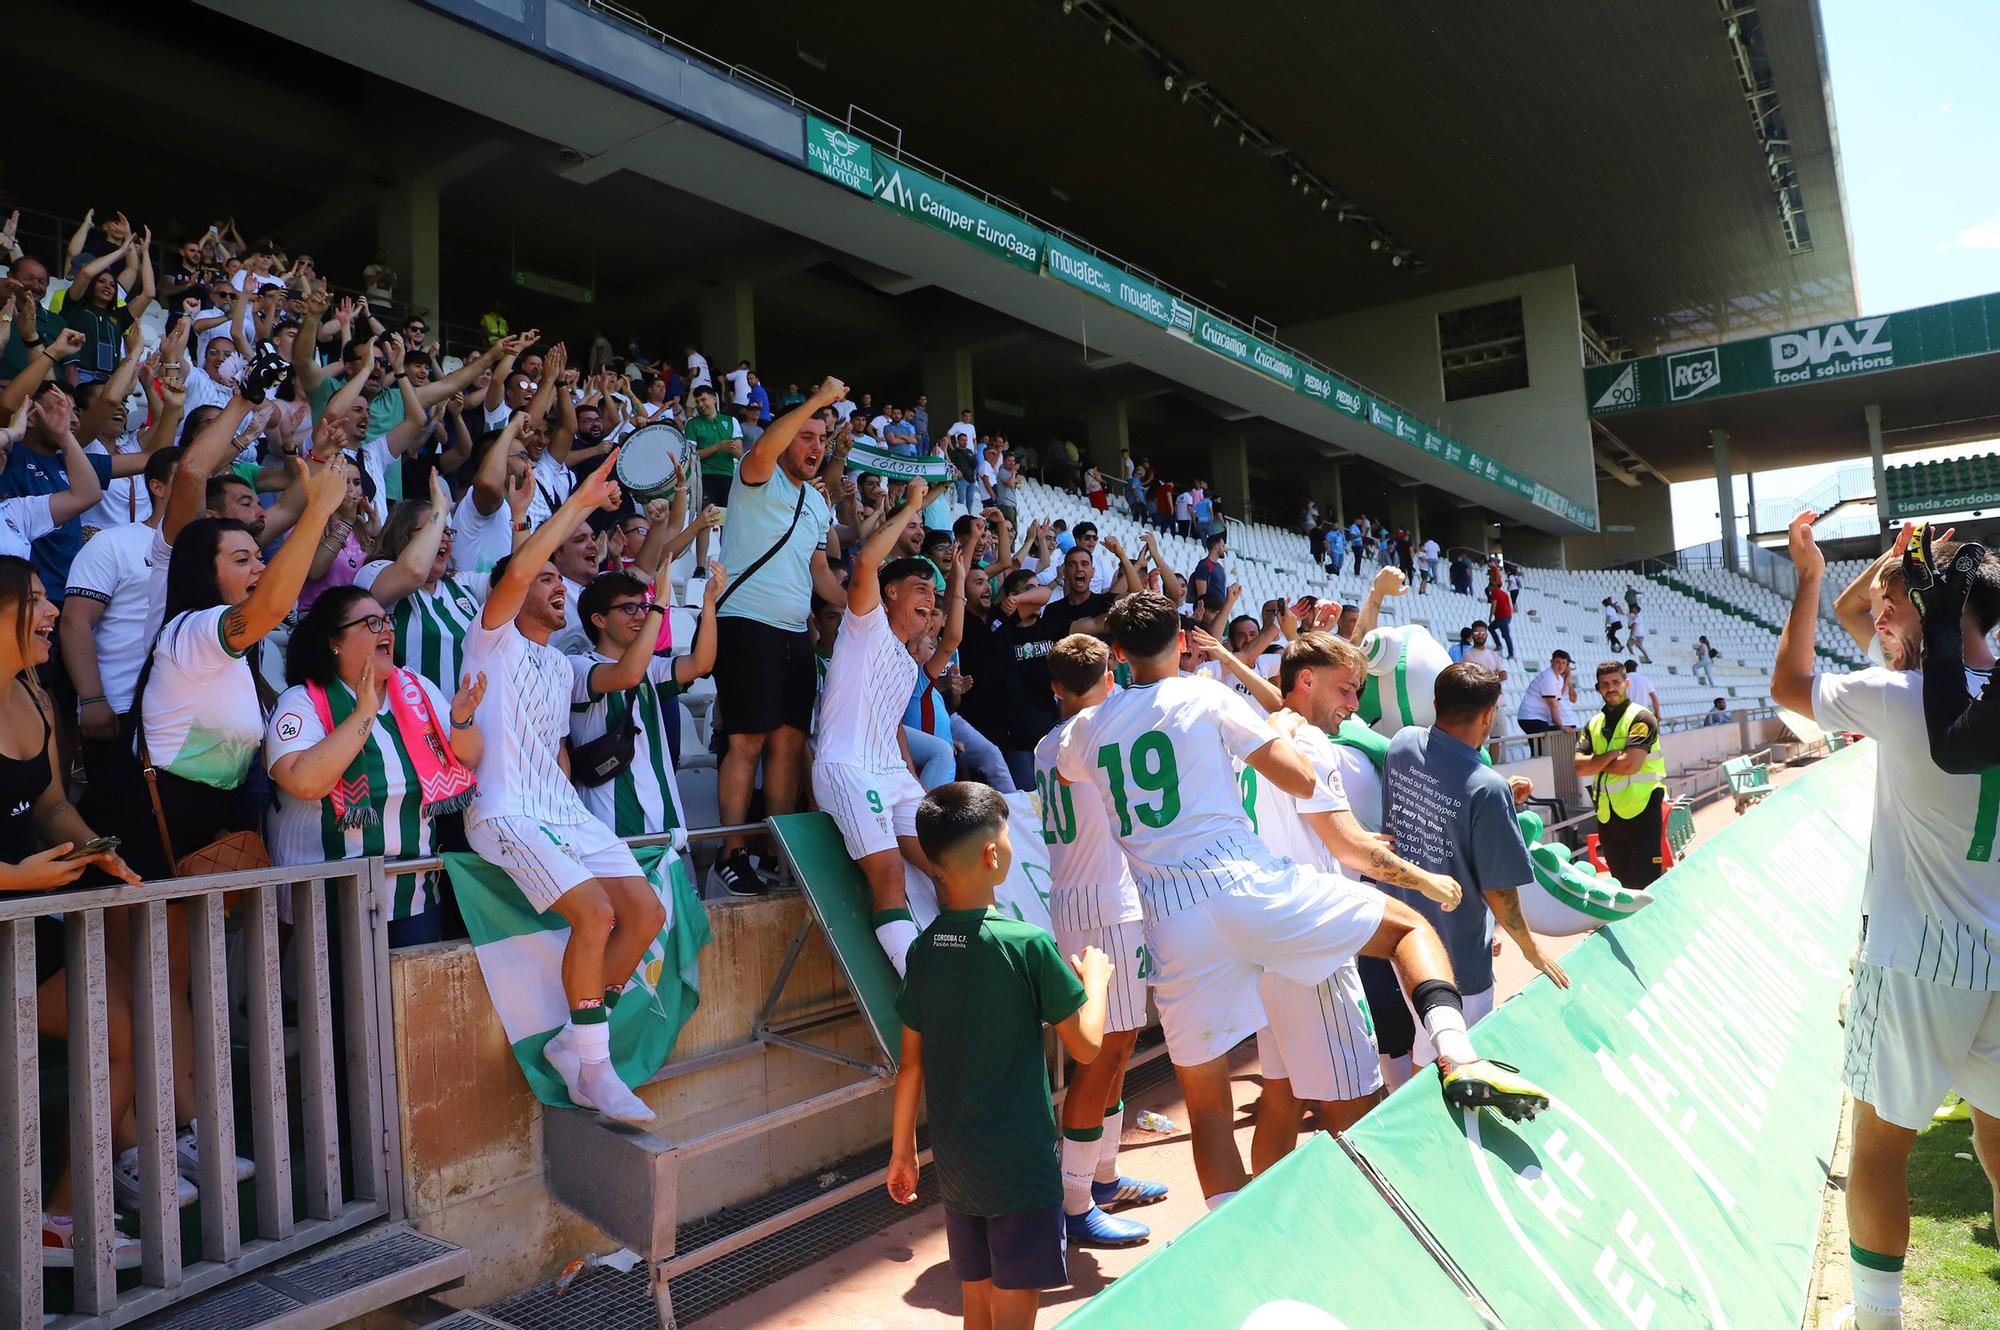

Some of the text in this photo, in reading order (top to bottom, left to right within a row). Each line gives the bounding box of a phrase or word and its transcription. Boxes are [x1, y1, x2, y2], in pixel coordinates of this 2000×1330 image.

[808, 143, 873, 182] SAN RAFAEL
[823, 162, 861, 189] MOTOR
[920, 192, 1037, 262] Camper EuroGaza
[517, 271, 525, 284] 5
[1202, 322, 1247, 358] Cruzcampo
[1770, 316, 1893, 370] DIAZ
[1254, 347, 1293, 379] Cruzcampo
[1675, 360, 1713, 388] RG3
[1774, 356, 1894, 384] food solutions
[1613, 387, 1634, 404] 90
[1097, 730, 1181, 838] 19
[866, 789, 884, 814] 9
[1434, 790, 1452, 806] trying
[1453, 799, 1461, 807] to
[1440, 816, 1447, 824] to
[1410, 845, 1422, 855] but
[933, 933, 957, 942] CÓRDOBA
